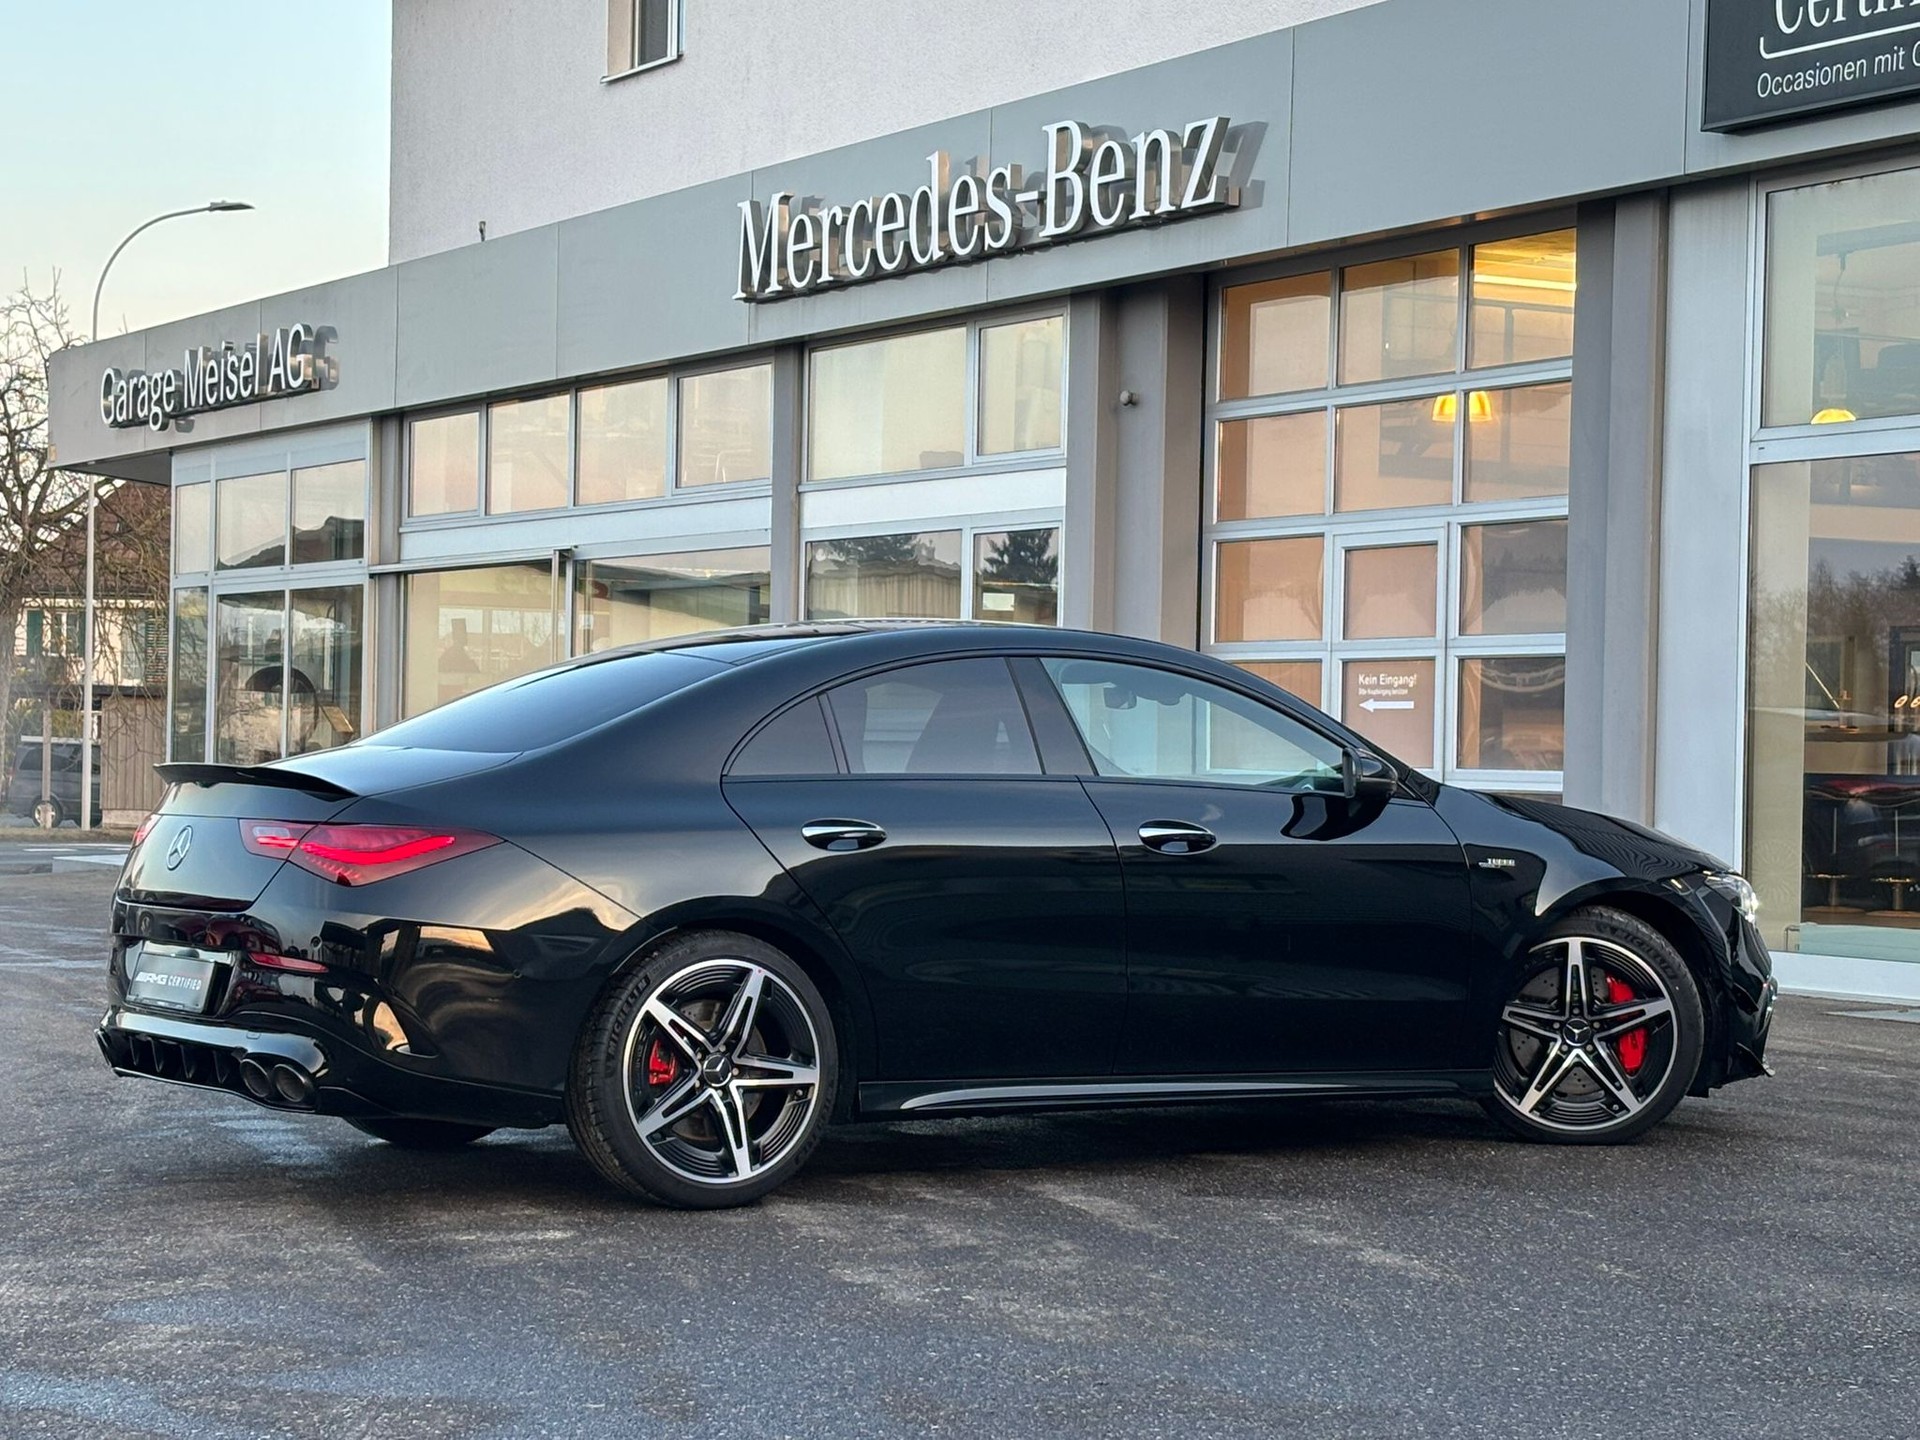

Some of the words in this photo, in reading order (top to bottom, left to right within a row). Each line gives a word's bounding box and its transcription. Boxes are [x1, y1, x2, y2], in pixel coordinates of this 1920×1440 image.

[1757, 58, 1867, 98] Occasionen
[1874, 45, 1905, 75] mit
[732, 116, 1231, 300] Mercedes-Benz
[100, 367, 176, 432] Garage
[184, 332, 262, 409] Meisel
[268, 322, 306, 394] AG
[1358, 673, 1377, 685] Kein
[168, 976, 201, 991] CERTIFIED
